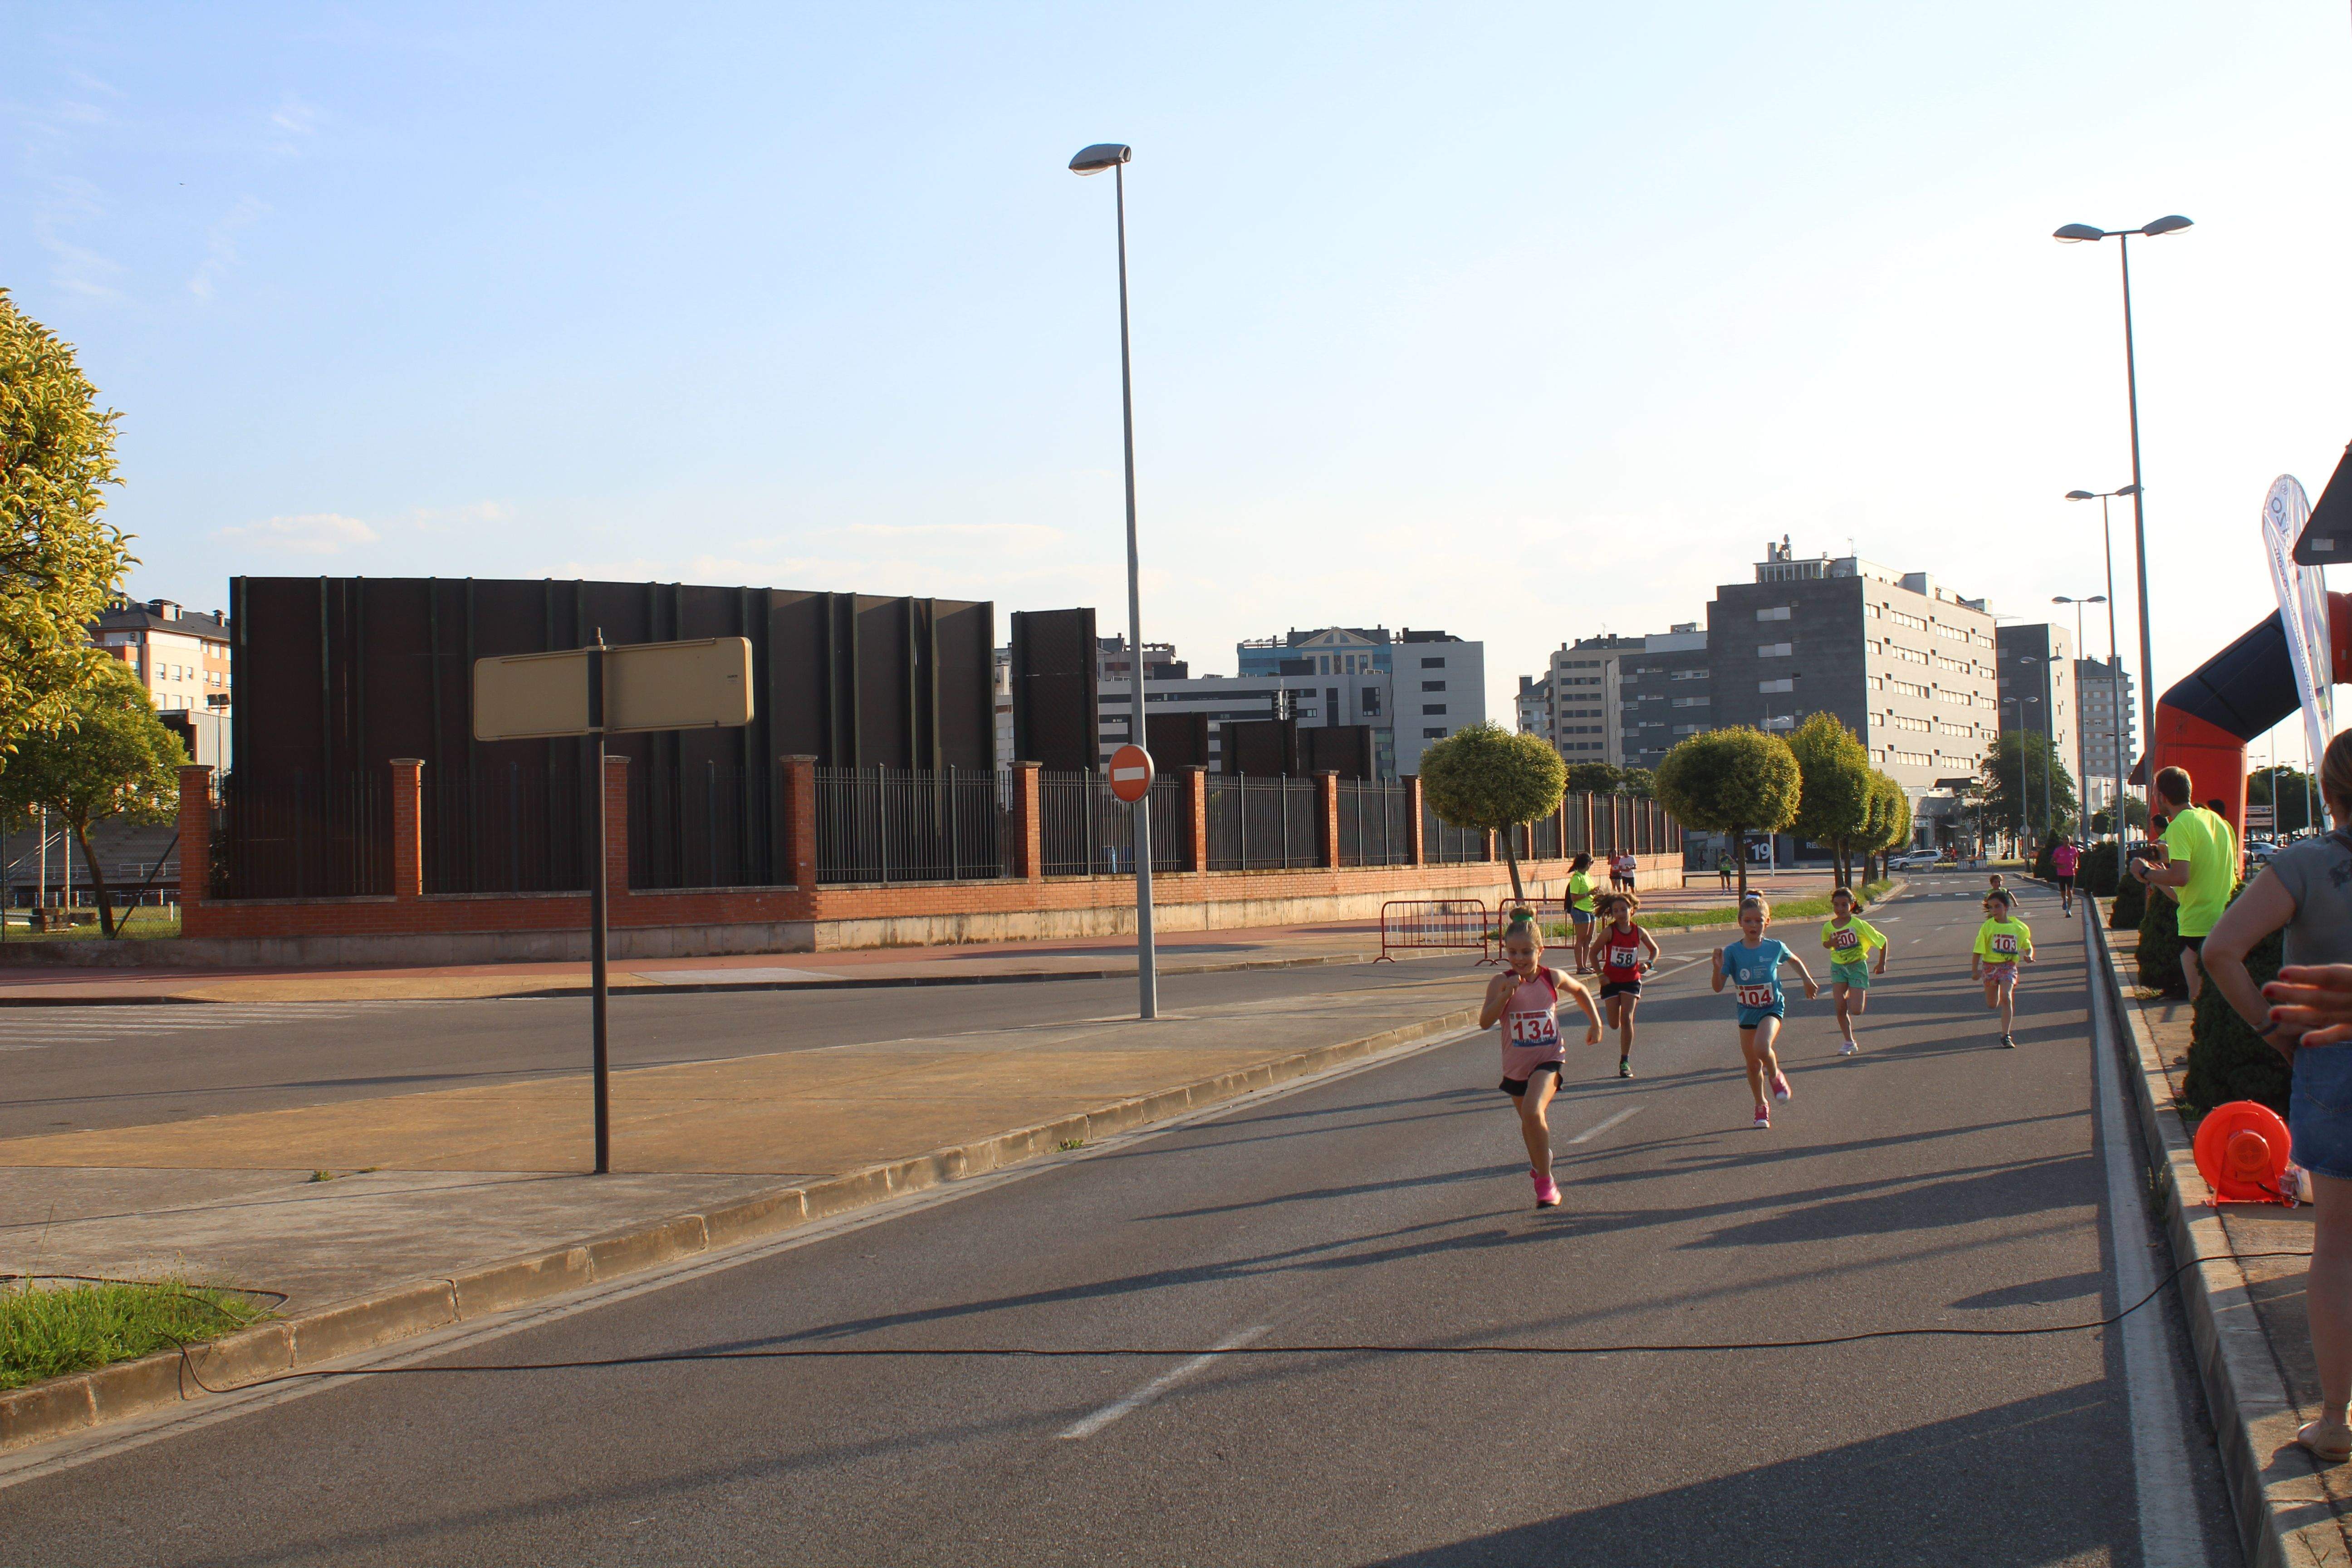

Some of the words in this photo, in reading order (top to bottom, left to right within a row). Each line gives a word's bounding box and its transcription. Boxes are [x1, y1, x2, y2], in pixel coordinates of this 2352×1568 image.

[1751, 843, 1770, 860] 19
[1994, 938, 2016, 951] 103
[1616, 953, 1632, 965] 58
[1739, 989, 1771, 1005] 104
[1514, 1019, 1554, 1040] 134
